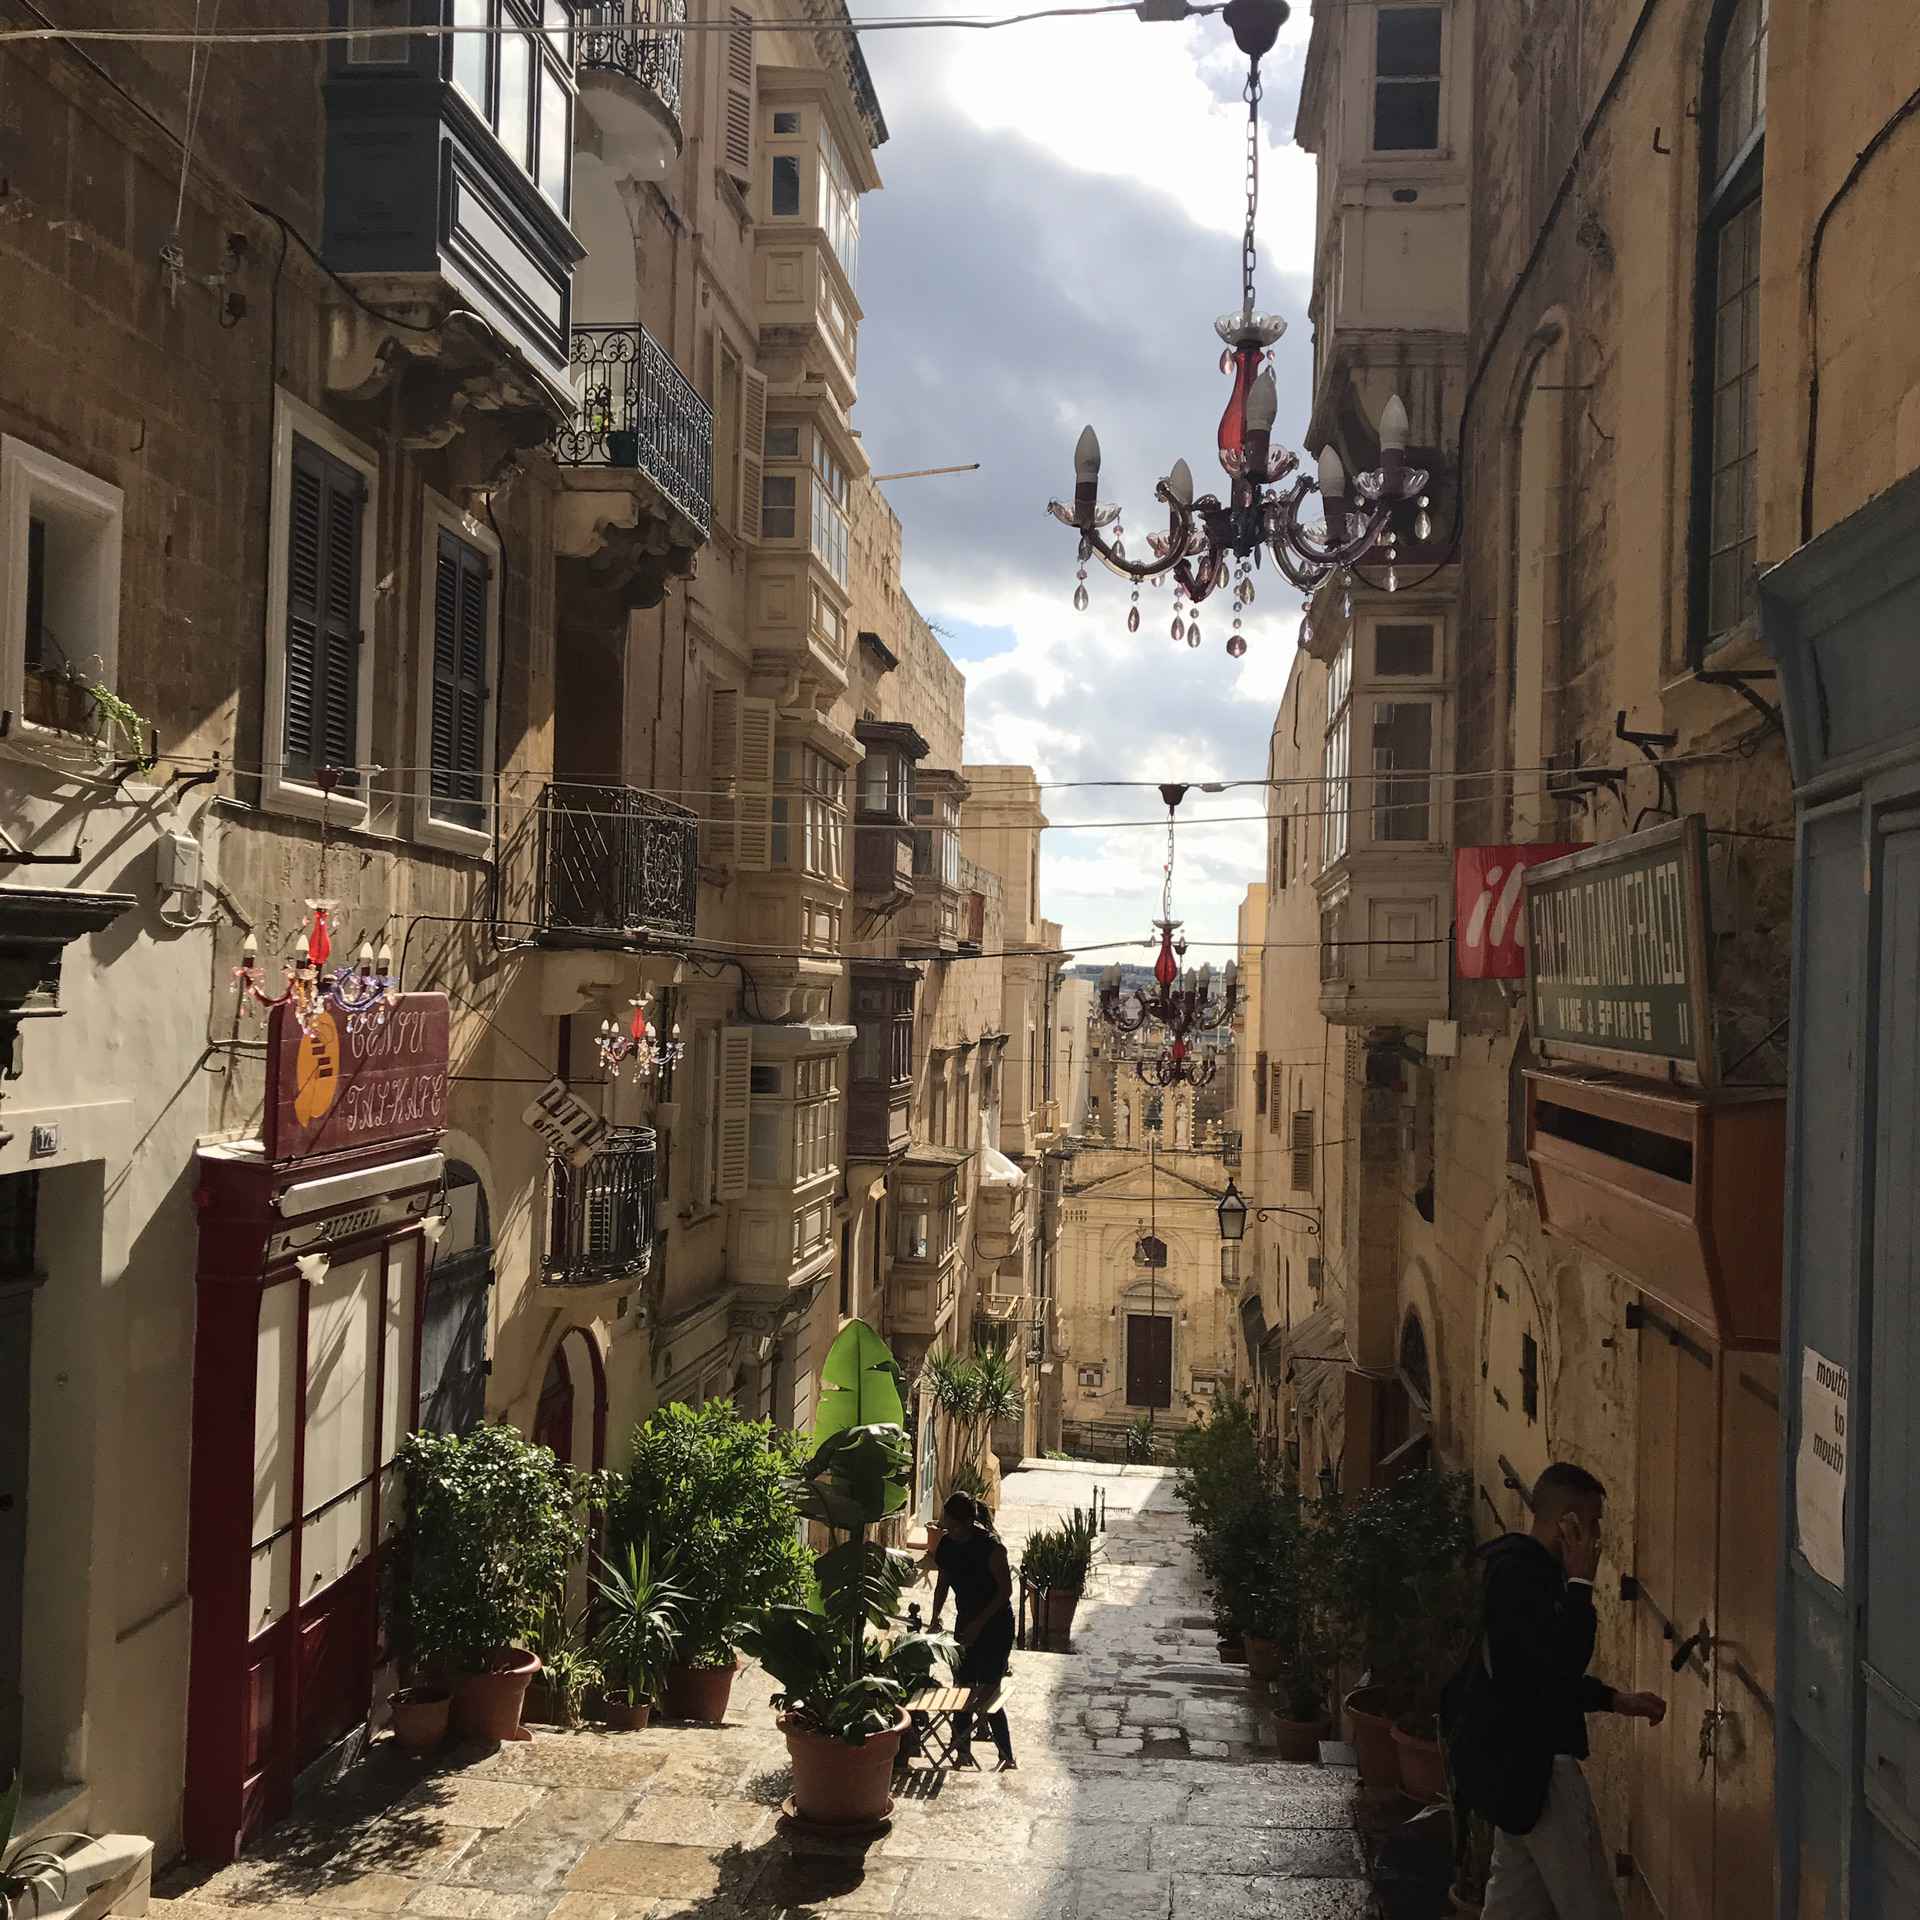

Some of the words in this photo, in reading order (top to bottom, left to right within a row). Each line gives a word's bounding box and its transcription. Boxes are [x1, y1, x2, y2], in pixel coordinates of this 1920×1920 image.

[1599, 999, 1653, 1040] SPIRITS
[533, 1119, 576, 1155] office
[1816, 1359, 1847, 1400] mouth
[1834, 1405, 1845, 1436] to
[1813, 1432, 1843, 1475] mouth
